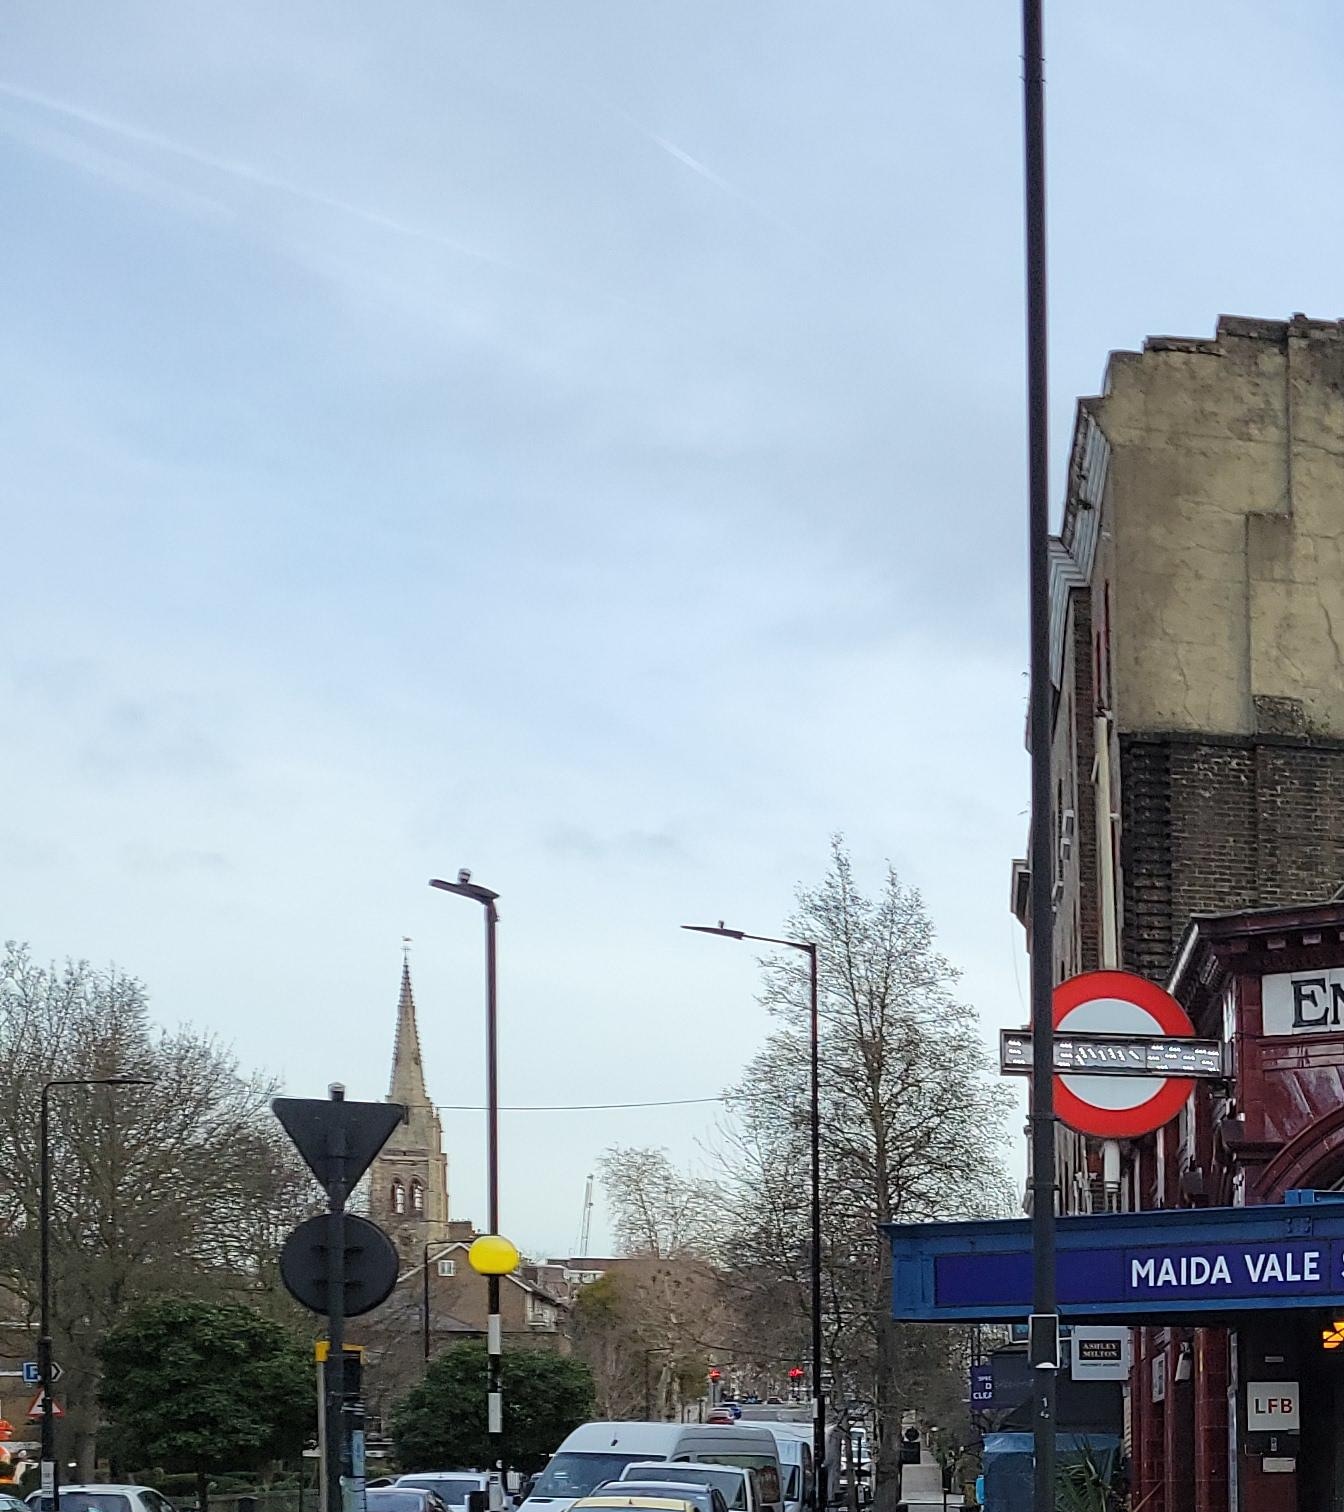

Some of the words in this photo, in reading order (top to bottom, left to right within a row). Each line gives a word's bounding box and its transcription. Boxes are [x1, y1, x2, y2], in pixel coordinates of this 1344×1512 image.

[1131, 1254, 1232, 1288] MAIDA
[1243, 1250, 1321, 1284] VALE
[1082, 1350, 1118, 1358] MILTON
[1255, 1398, 1293, 1414] LFB
